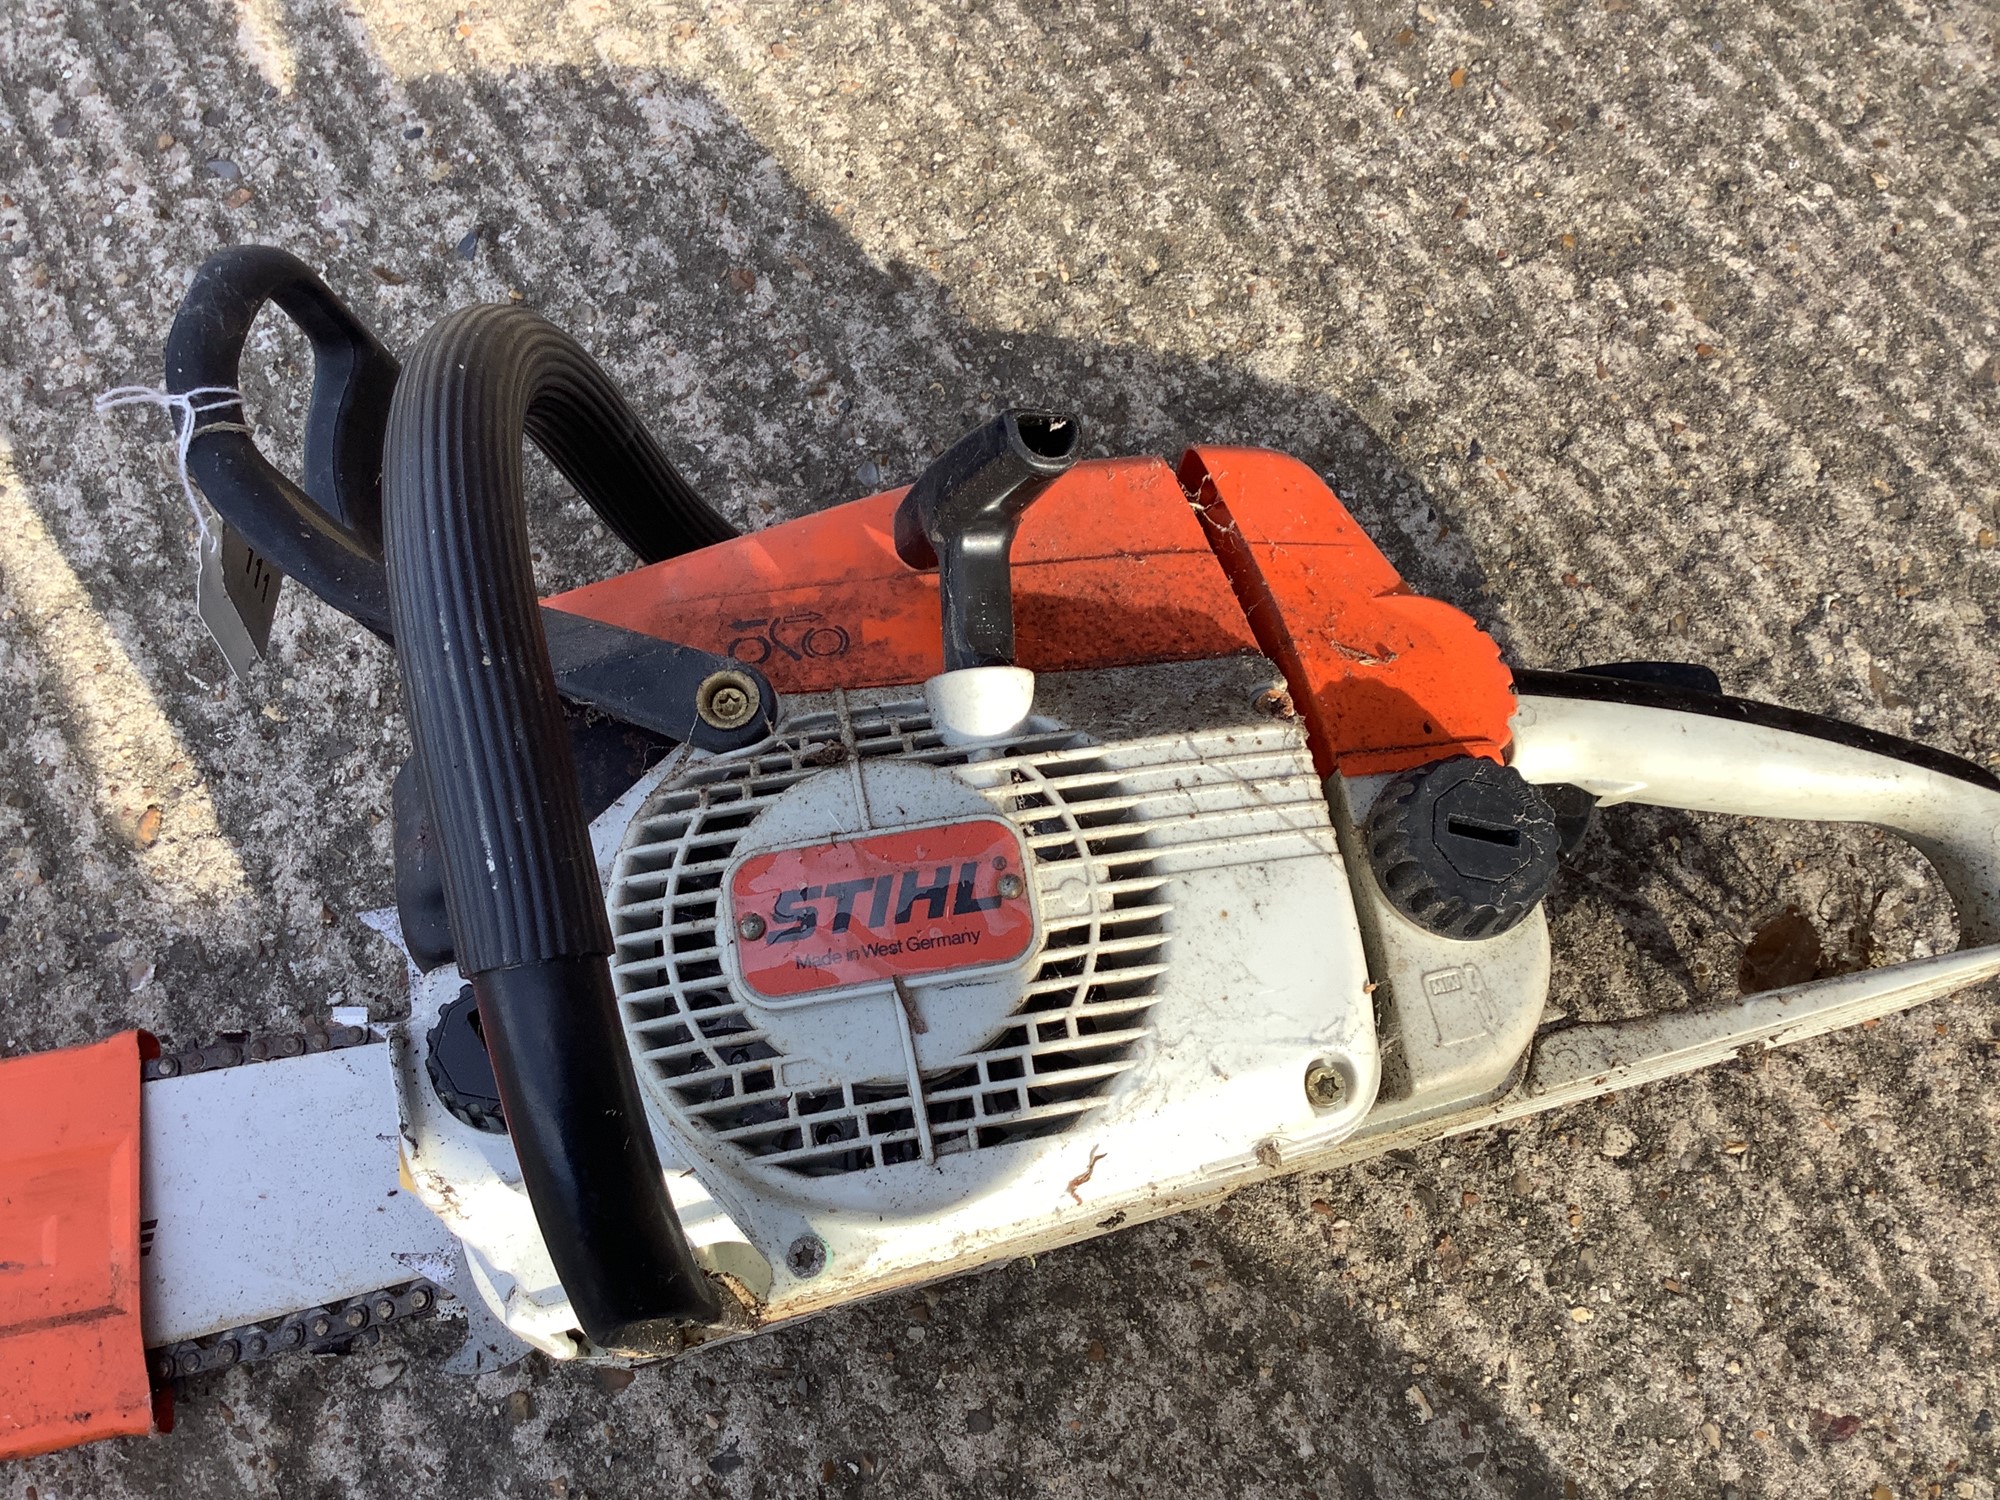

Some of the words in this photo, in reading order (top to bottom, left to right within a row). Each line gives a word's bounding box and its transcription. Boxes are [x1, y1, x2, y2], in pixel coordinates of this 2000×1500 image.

[766, 861, 1002, 945] STIHL
[795, 947, 843, 970] Made
[846, 948, 860, 962] in
[862, 939, 904, 959] West
[906, 930, 981, 951] Germany
